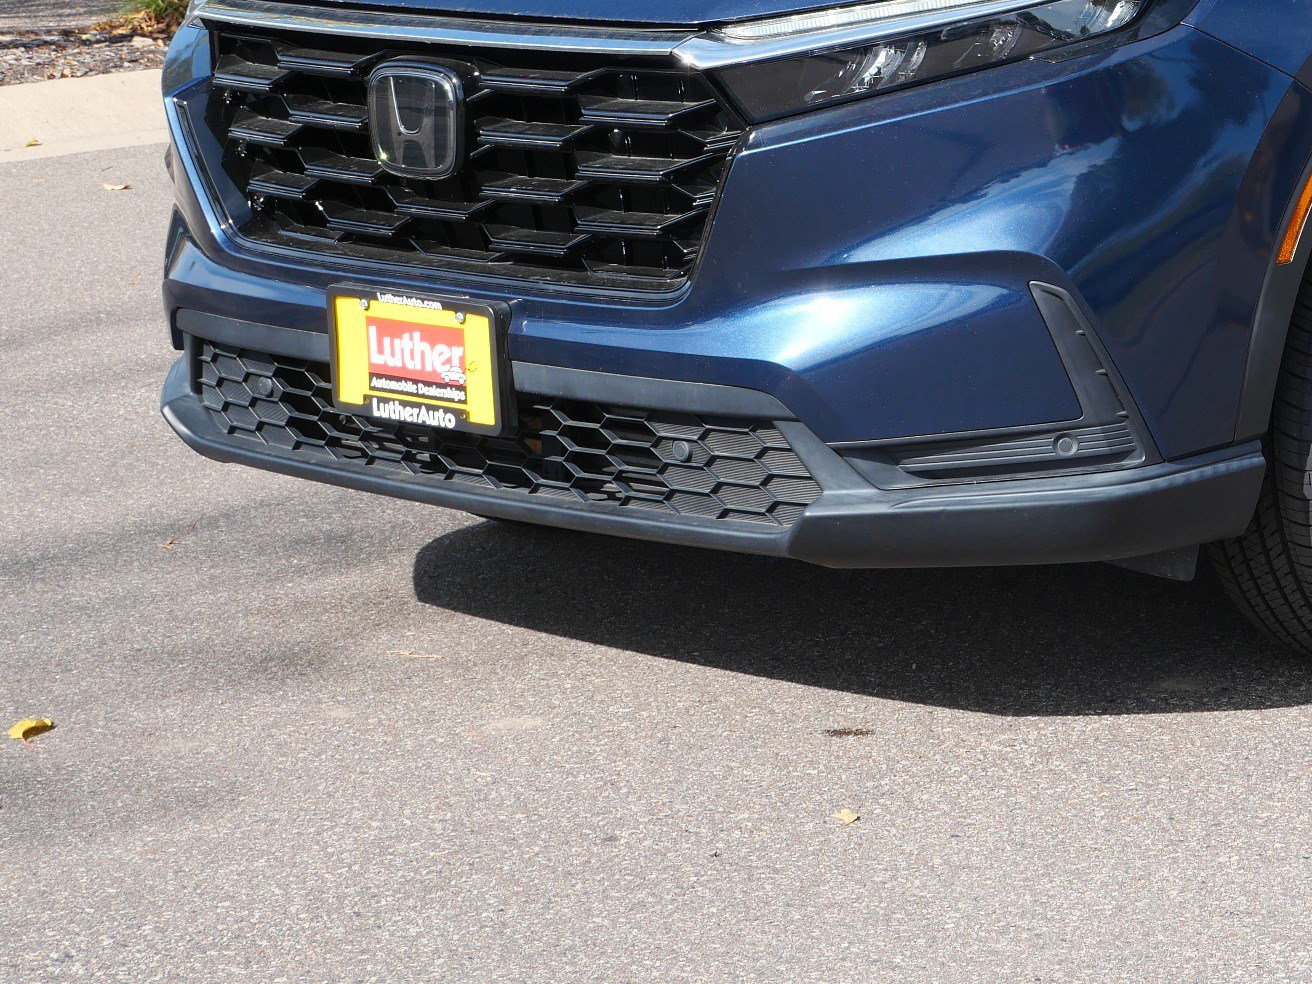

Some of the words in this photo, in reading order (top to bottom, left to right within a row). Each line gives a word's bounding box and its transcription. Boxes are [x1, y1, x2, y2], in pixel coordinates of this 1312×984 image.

[376, 292, 442, 310] LutherAuto.com
[368, 326, 464, 372] Luther
[371, 376, 418, 394] Automobile
[418, 383, 466, 402] Dealerships
[372, 398, 456, 428] LutherAuto
